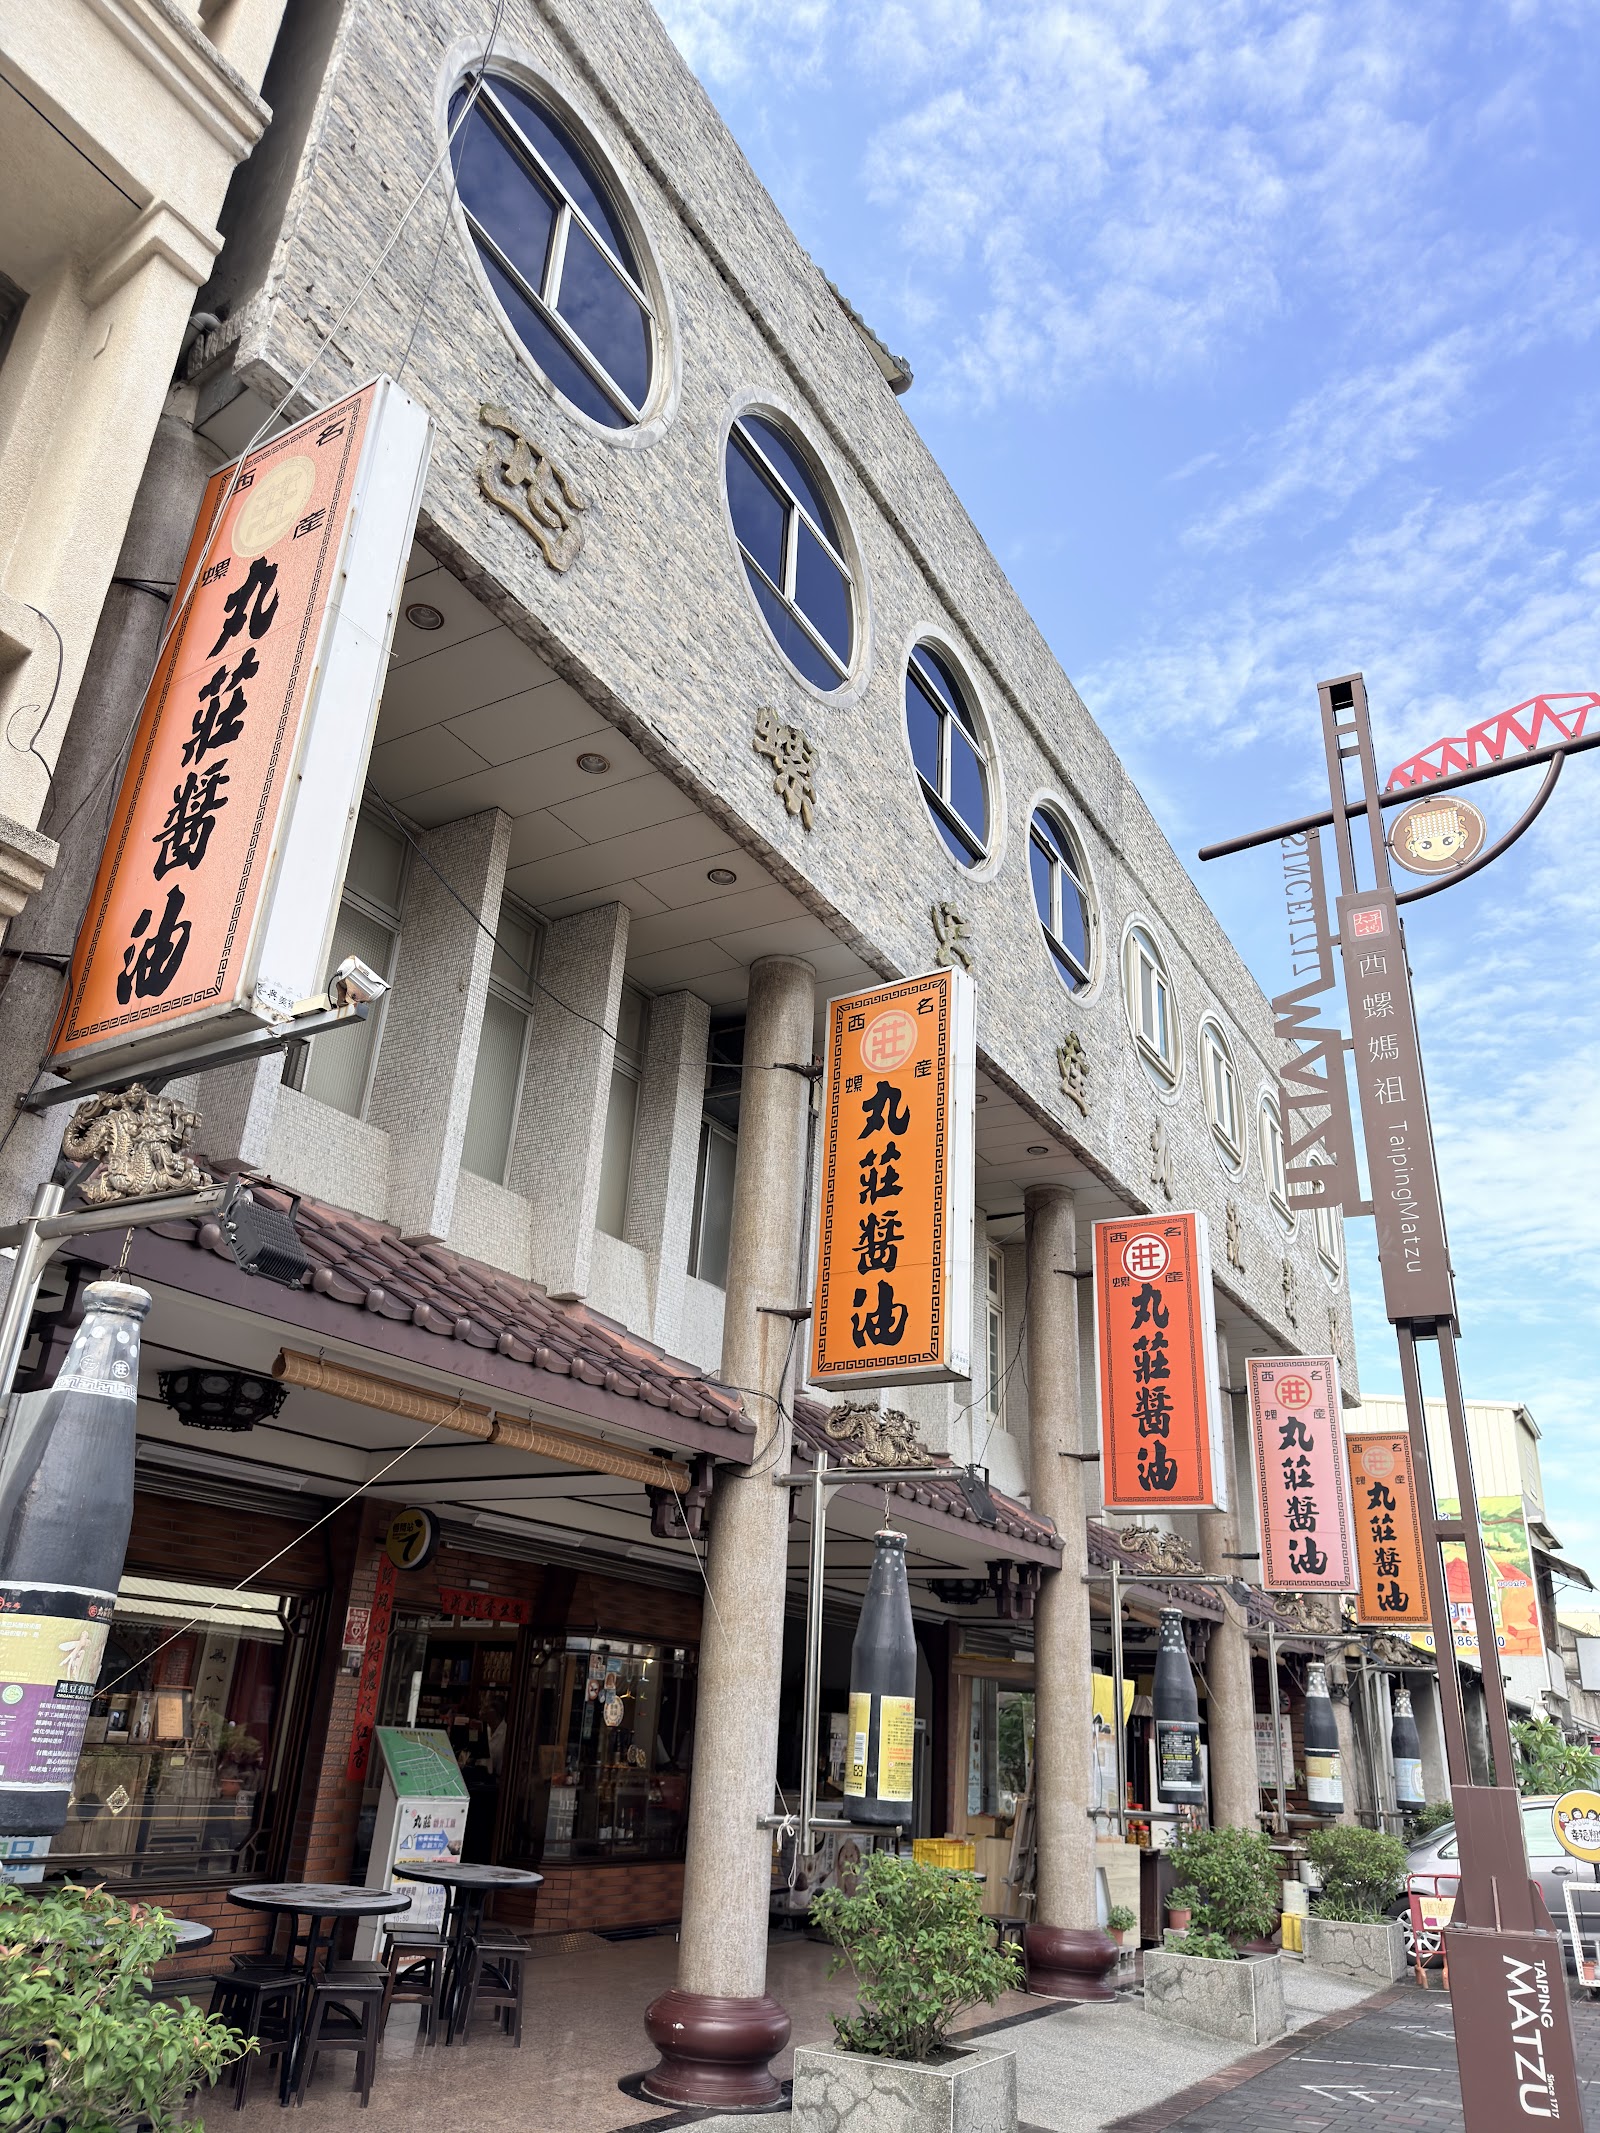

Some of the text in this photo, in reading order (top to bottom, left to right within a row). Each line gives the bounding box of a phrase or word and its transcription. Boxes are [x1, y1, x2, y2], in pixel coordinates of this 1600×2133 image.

[117, 555, 278, 1005] 丸莊醬油
[872, 1020, 906, 1060] 莊
[1357, 950, 1406, 1105] 西螺媽祖
[852, 1080, 910, 1349] 丸莊醬油
[1132, 1243, 1161, 1271] 莊
[1131, 1283, 1178, 1491] 丸莊醬油
[1278, 1416, 1328, 1575] 丸莊醬油
[1366, 1481, 1409, 1612] 丸莊醬油
[1503, 1955, 1551, 2117] MATZU
[1534, 1960, 1554, 2028] TAIPING
[1547, 2073, 1560, 2119] Since 1717
